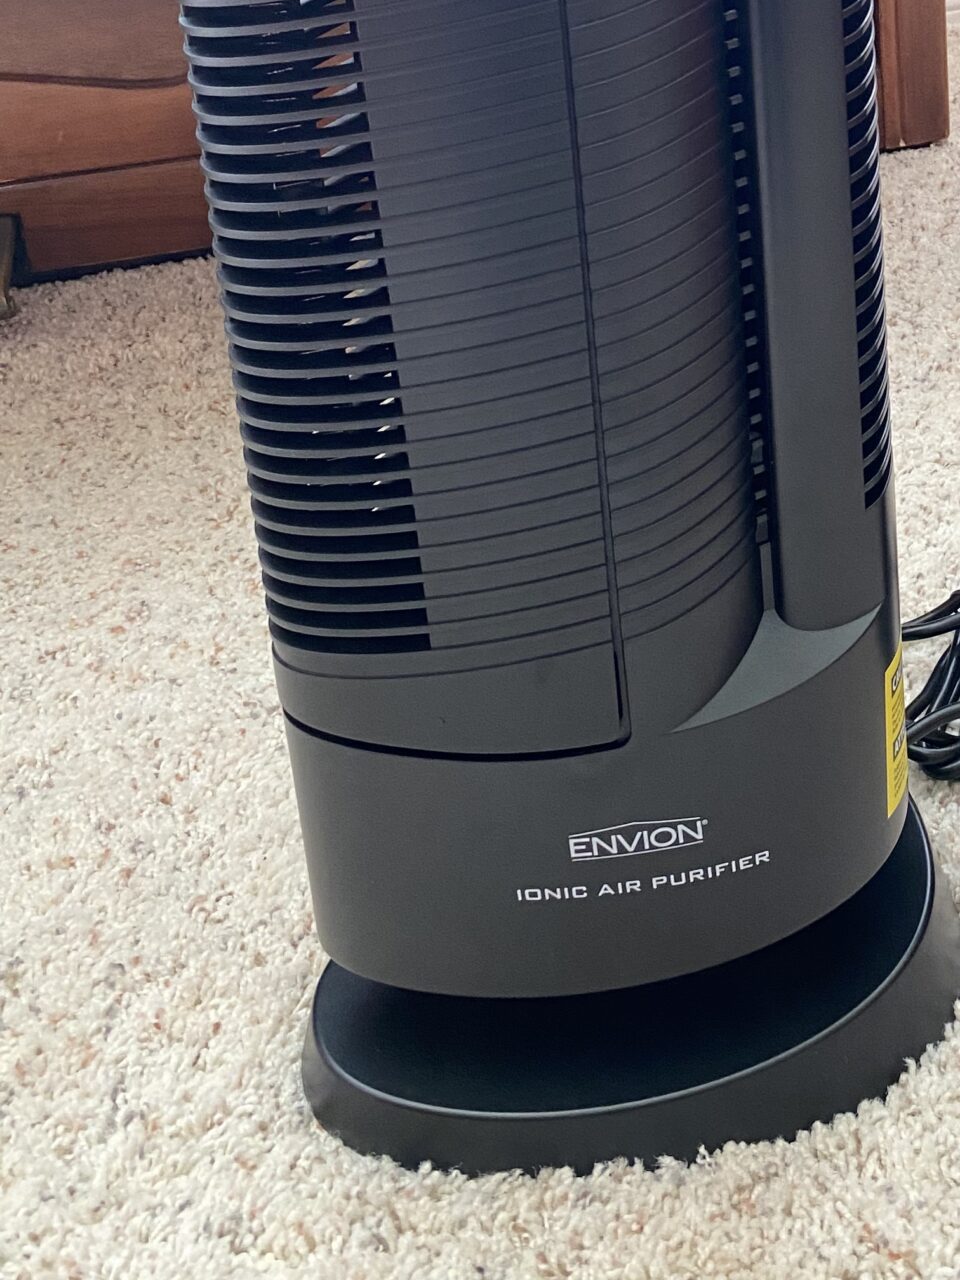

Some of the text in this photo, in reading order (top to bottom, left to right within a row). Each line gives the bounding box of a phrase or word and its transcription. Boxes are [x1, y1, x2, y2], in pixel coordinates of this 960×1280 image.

[516, 850, 771, 902] IONIC AIR PURIFIER
